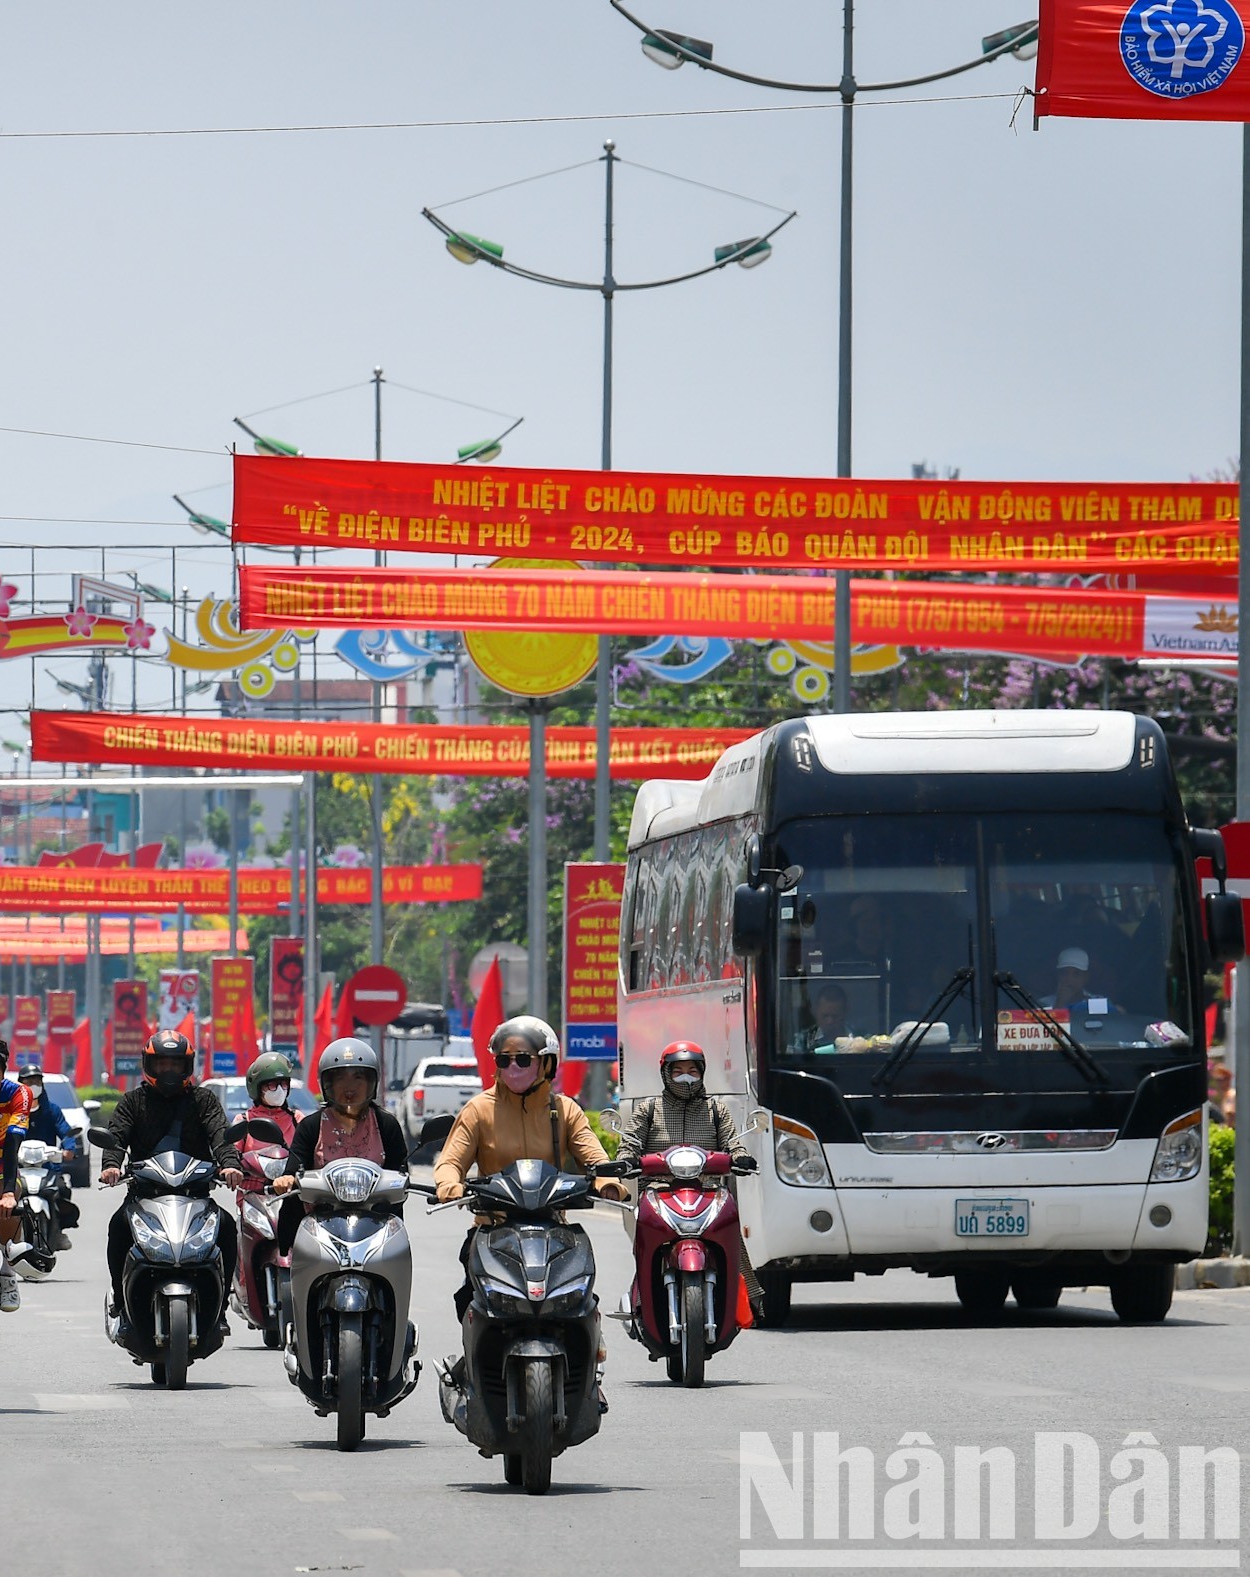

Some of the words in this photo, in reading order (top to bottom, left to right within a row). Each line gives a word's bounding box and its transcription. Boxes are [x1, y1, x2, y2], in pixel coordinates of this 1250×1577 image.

[1124, 35, 1138, 60] BẢO
[1218, 44, 1239, 75] NAM
[1130, 59, 1156, 87] HIỂM
[1154, 79, 1171, 93] XÃ
[1197, 71, 1223, 91] VIỆT
[1174, 83, 1197, 96] HỘI
[434, 476, 510, 512] NHIỆT
[517, 480, 570, 515] LIỆT
[585, 483, 656, 513] CHÀO
[667, 484, 746, 516] MỪNG
[754, 488, 807, 518] CÁC
[815, 488, 888, 519] ĐOÀN
[918, 490, 971, 525] VẬN
[979, 490, 1051, 525] ĐỘNG
[1061, 491, 1120, 521] VIÊN
[1128, 496, 1202, 521] THAM
[338, 512, 400, 544] ĐIỆN
[408, 514, 470, 545] BIÊN
[479, 514, 531, 547] PHỦ
[571, 526, 644, 555] 2024,
[669, 524, 721, 555] CÚP
[736, 530, 790, 557] BÁO
[805, 532, 877, 561] QUÂN
[885, 531, 929, 563] ĐỘI
[950, 534, 1025, 560] NHÂN
[1115, 531, 1167, 561] CÁC
[265, 578, 326, 621] NHIỆT
[334, 578, 376, 621] LIỆT
[382, 578, 438, 619] CHÀO
[449, 578, 508, 619] MỪNG
[514, 586, 538, 619] 70
[545, 580, 595, 620] NĂM
[601, 578, 666, 622] CHIẾN
[671, 578, 740, 623] THẮNG
[747, 583, 797, 630] ĐIỆN
[802, 583, 836, 626] BIÊ
[857, 585, 899, 629] PHỦ
[104, 724, 159, 751] CHIẾN
[163, 726, 223, 754] THẮNG
[228, 731, 271, 758] ĐIỆN
[275, 730, 317, 757] BIÊN
[322, 732, 358, 758] PHỦ
[375, 731, 430, 760] CHIẾN
[435, 734, 493, 762] THẮNG
[639, 736, 672, 763] KẾT
[1004, 1028, 1017, 1039] XE
[986, 1215, 1025, 1233] 5899
